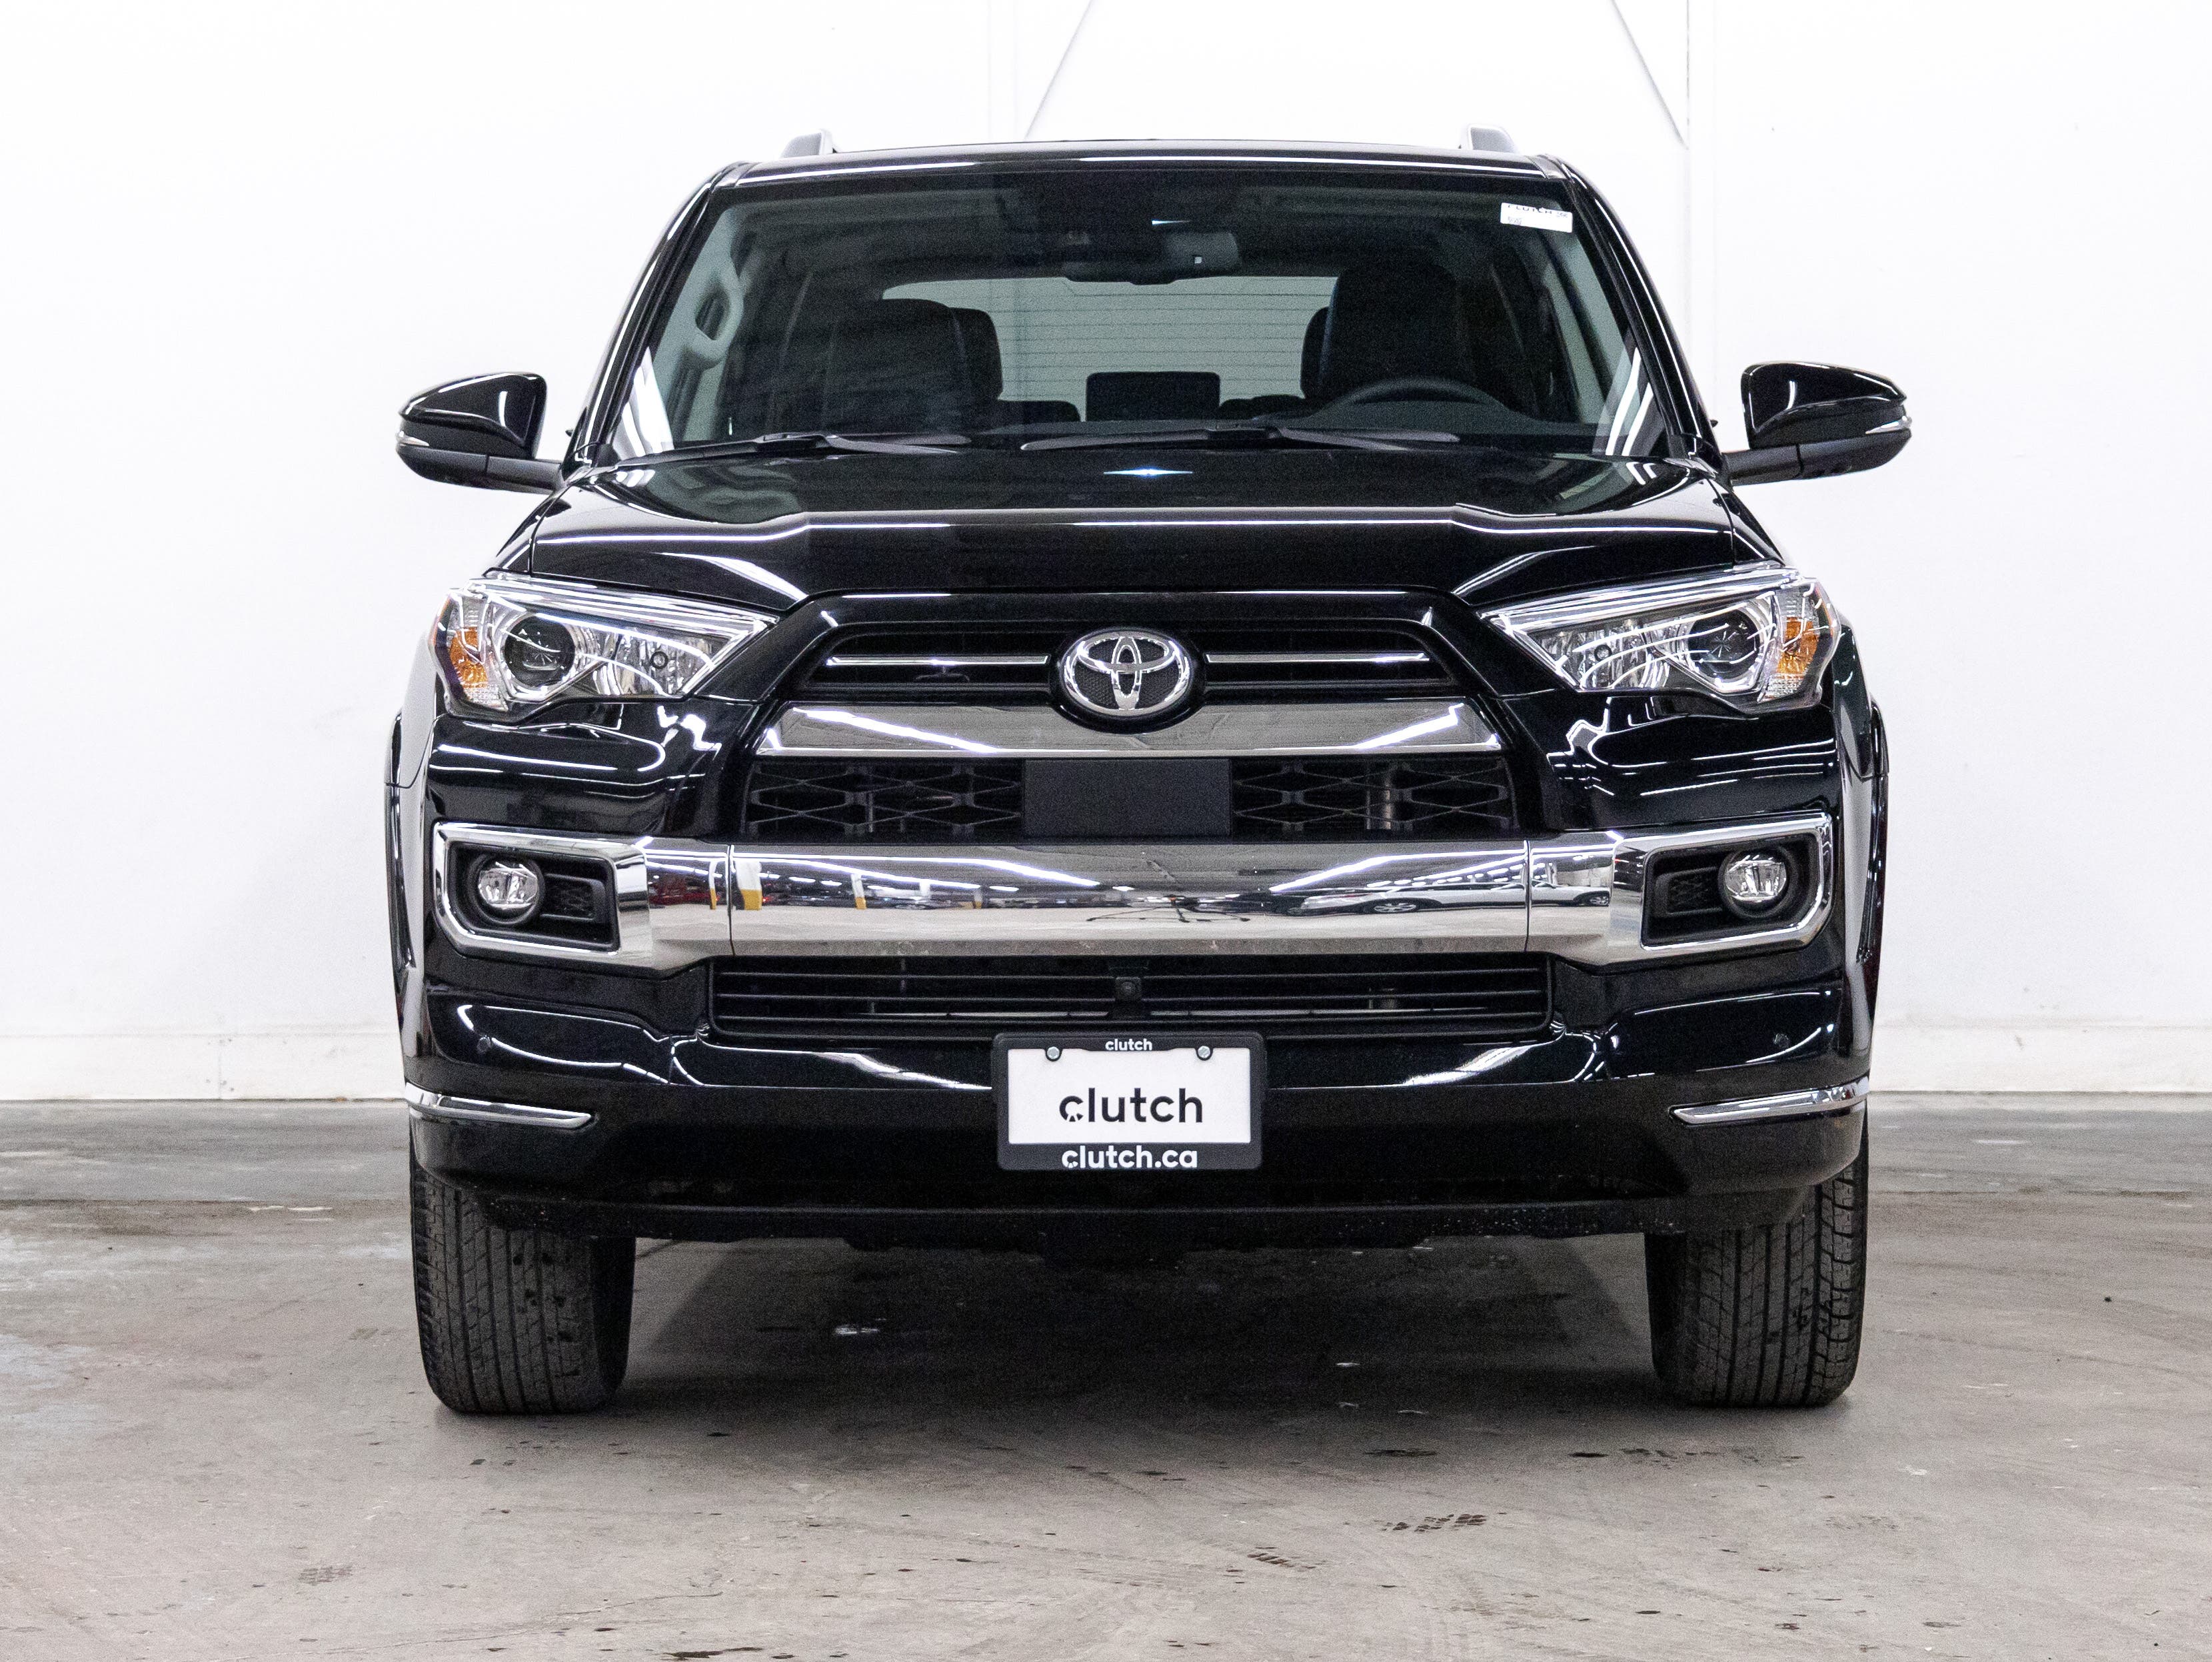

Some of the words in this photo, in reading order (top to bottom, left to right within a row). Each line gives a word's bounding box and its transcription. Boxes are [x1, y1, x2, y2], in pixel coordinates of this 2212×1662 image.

[1105, 1038, 1153, 1051] clutch
[1059, 1088, 1202, 1123] clutch
[1061, 1145, 1198, 1169] clutch.ca
